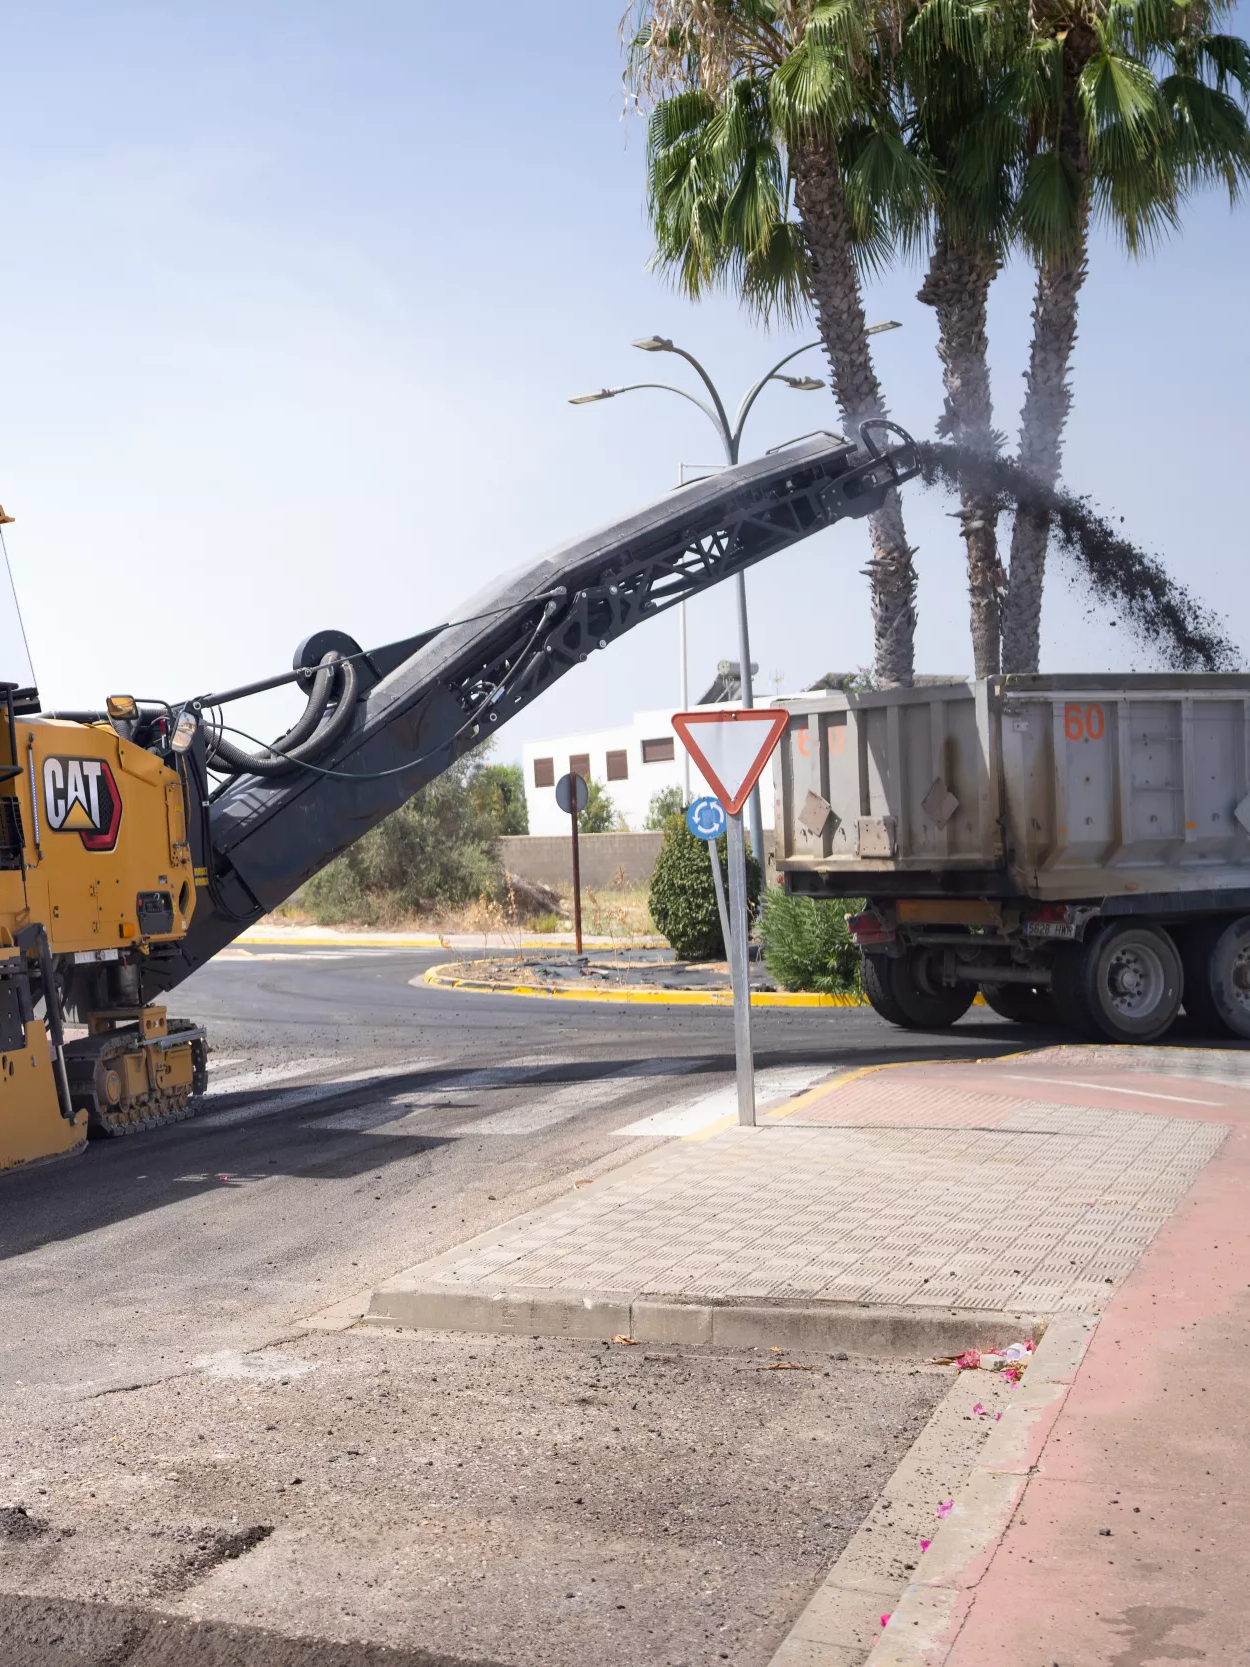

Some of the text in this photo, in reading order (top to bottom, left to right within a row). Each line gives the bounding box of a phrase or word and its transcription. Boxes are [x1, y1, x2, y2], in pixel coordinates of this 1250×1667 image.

[797, 724, 845, 757] 60
[1065, 703, 1105, 741] 60
[43, 757, 102, 829] CAT
